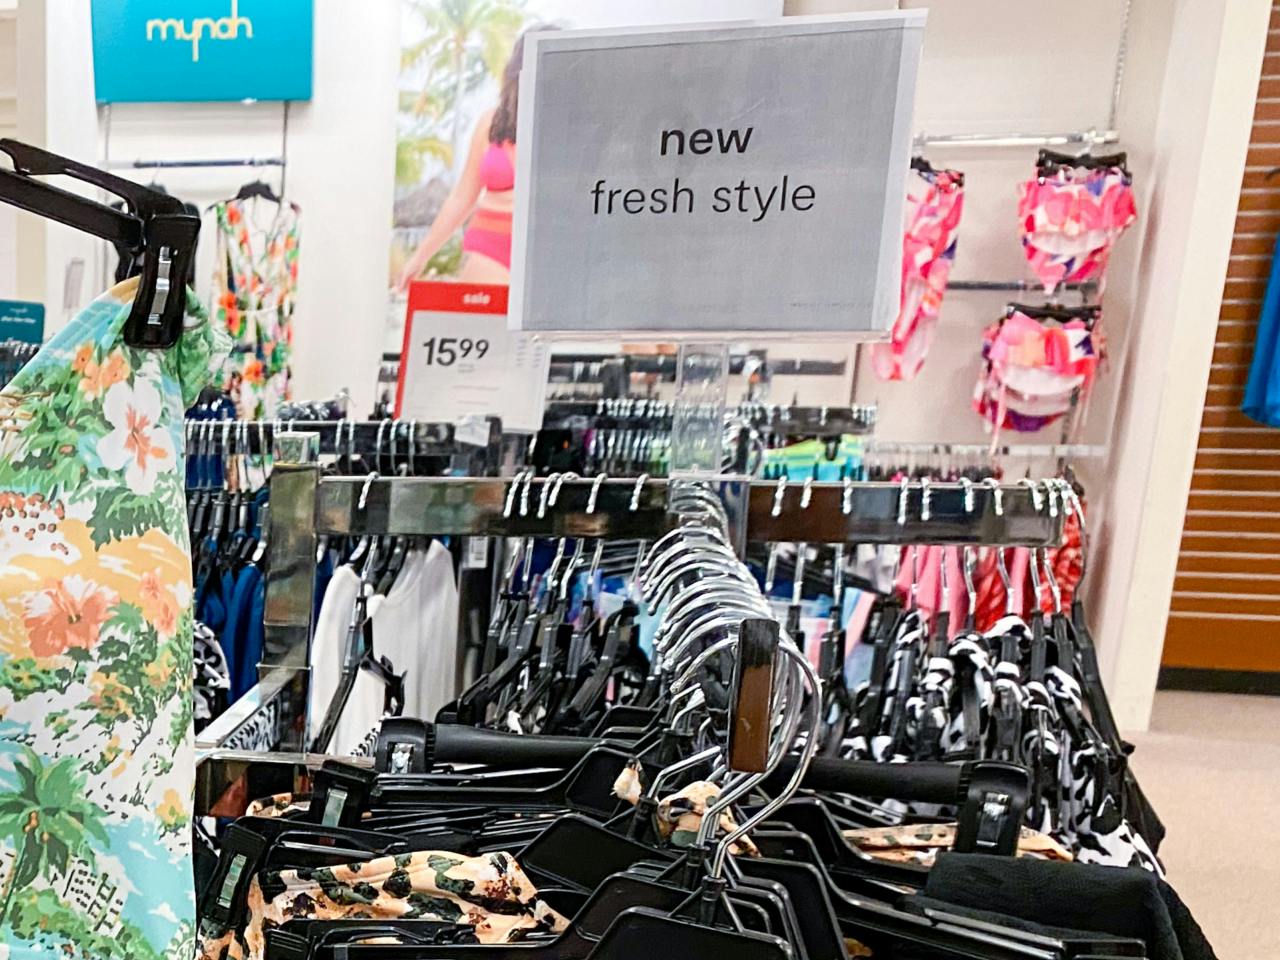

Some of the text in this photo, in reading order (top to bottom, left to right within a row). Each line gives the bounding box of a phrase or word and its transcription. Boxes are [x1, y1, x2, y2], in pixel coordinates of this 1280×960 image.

[146, 0, 253, 62] mynah
[660, 127, 754, 156] new
[590, 175, 816, 222] fresh style
[463, 292, 491, 305] sale
